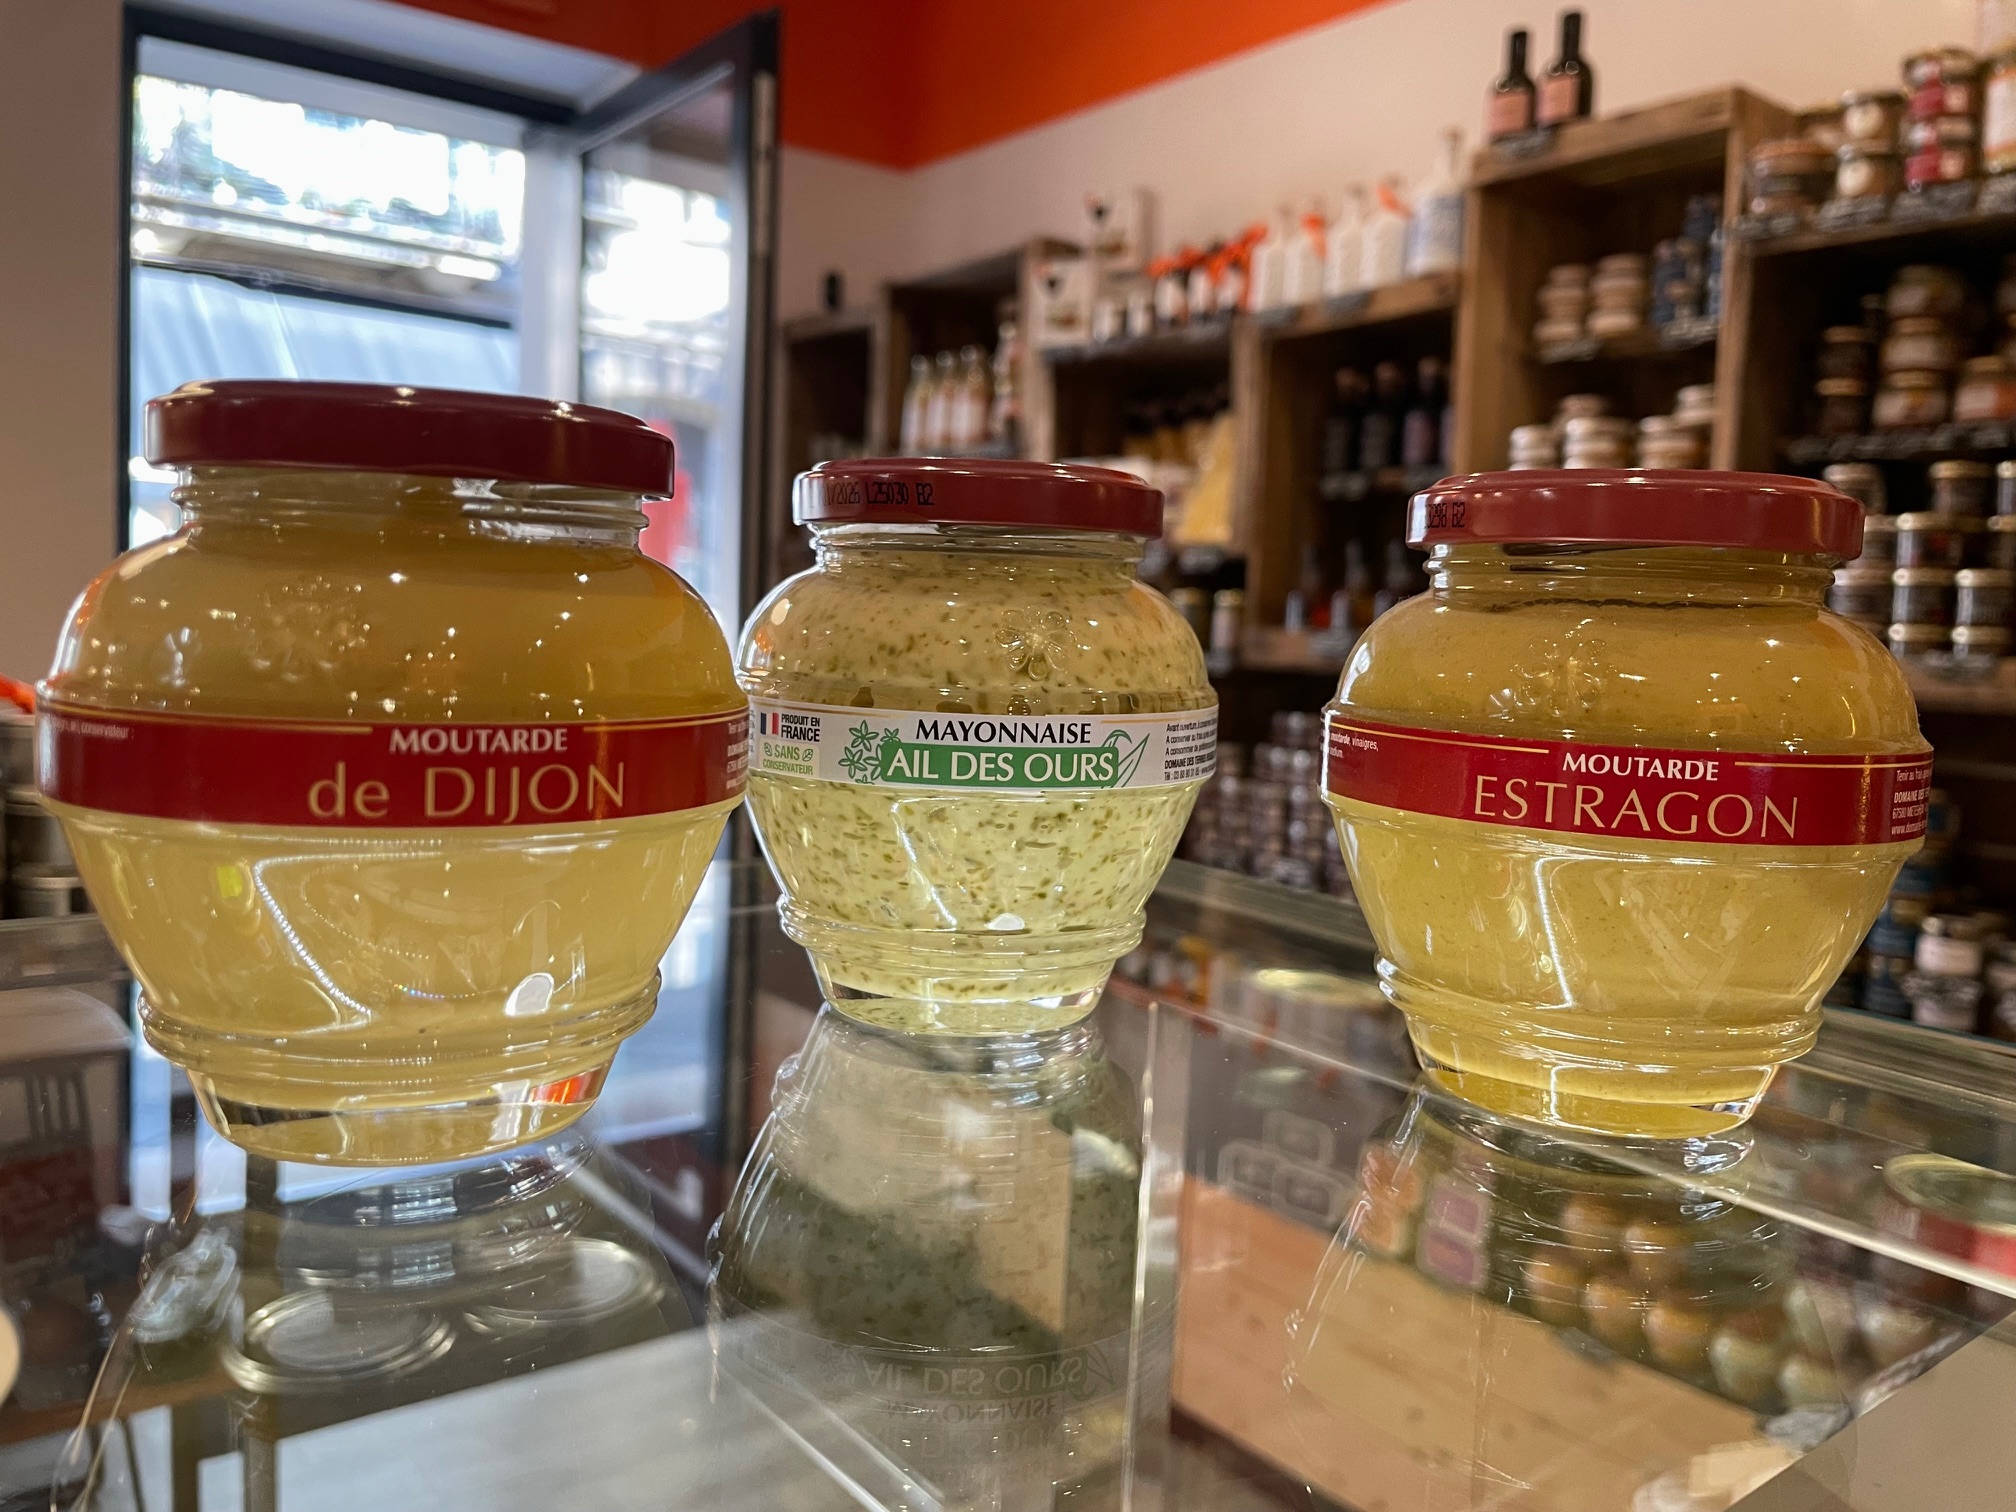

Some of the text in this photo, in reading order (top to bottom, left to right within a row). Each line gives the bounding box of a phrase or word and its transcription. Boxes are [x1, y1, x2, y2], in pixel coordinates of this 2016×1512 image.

[915, 482, 936, 506] B2
[1451, 502, 1466, 528] B2
[781, 713, 821, 727] PRODUIT EN
[916, 718, 1092, 744] MAYONNAISE
[389, 727, 568, 755] MOUTARDE
[781, 725, 821, 742] FRANCE
[1352, 736, 1379, 752] vinaigres,
[774, 744, 800, 761] SANS
[1164, 758, 1187, 769] DOMAINE
[762, 758, 813, 775] CONSERVATEUR
[886, 748, 1114, 782] AIL DES OURS
[1562, 752, 1719, 781] MOUTARDE
[307, 761, 624, 824] de DIJON
[1893, 789, 1918, 803] DOMAINE
[1474, 774, 1798, 839] ESTRAGON
